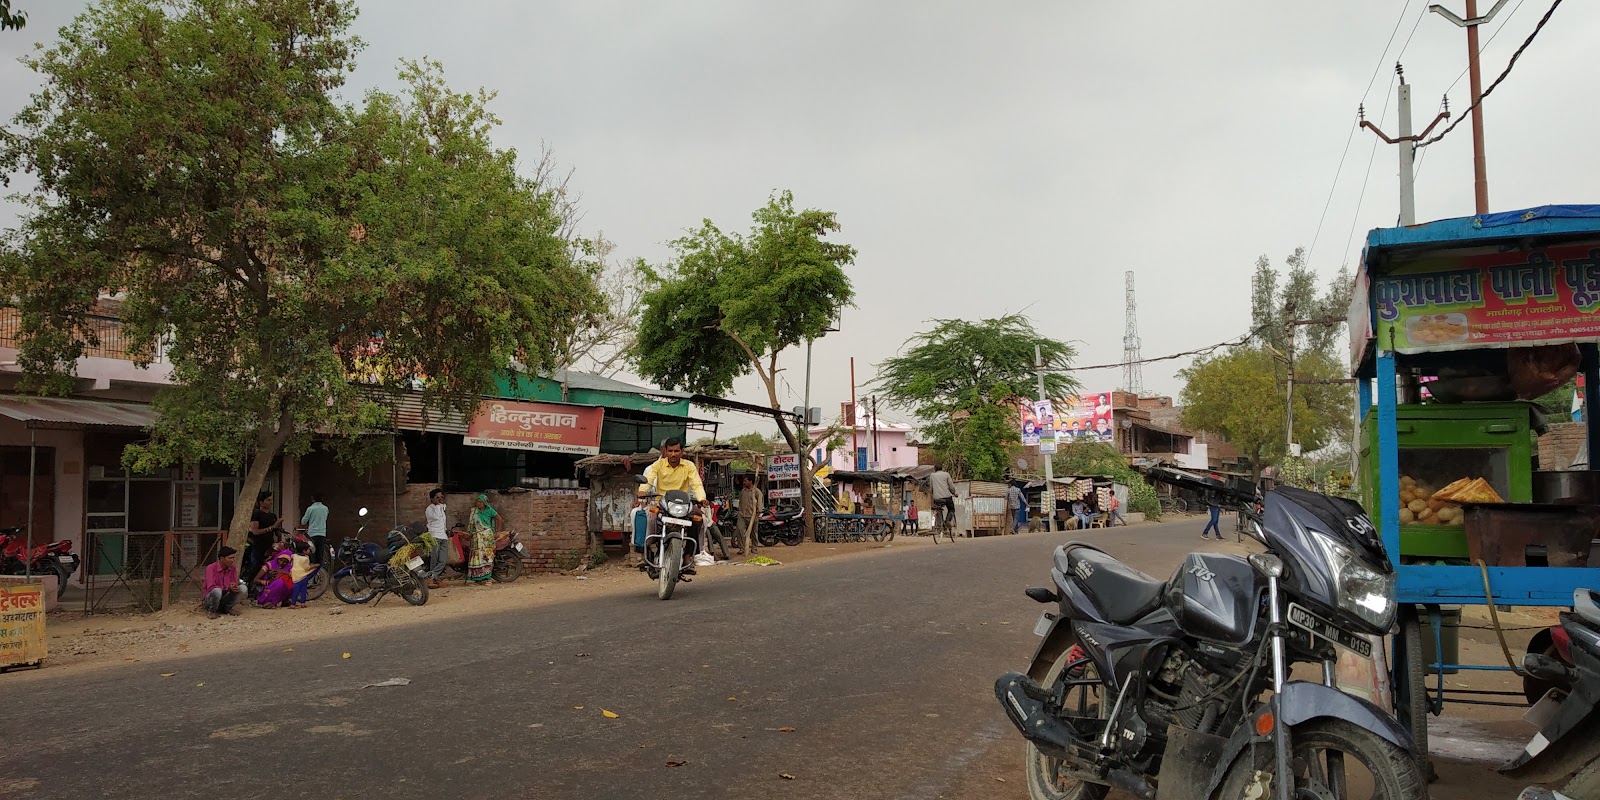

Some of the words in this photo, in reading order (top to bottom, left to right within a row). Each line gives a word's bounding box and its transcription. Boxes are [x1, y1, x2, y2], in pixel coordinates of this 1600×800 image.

[1376, 269, 1483, 321] कुशवाहा
[1489, 252, 1558, 302] पानी
[490, 404, 579, 430] हिन्दुस्तान
[774, 456, 793, 464] होटल
[1188, 564, 1217, 581] TVS
[1292, 607, 1315, 629] MP30
[1324, 624, 1340, 642] MM
[1350, 637, 1370, 656] 0155
[1122, 728, 1136, 741] TVS
